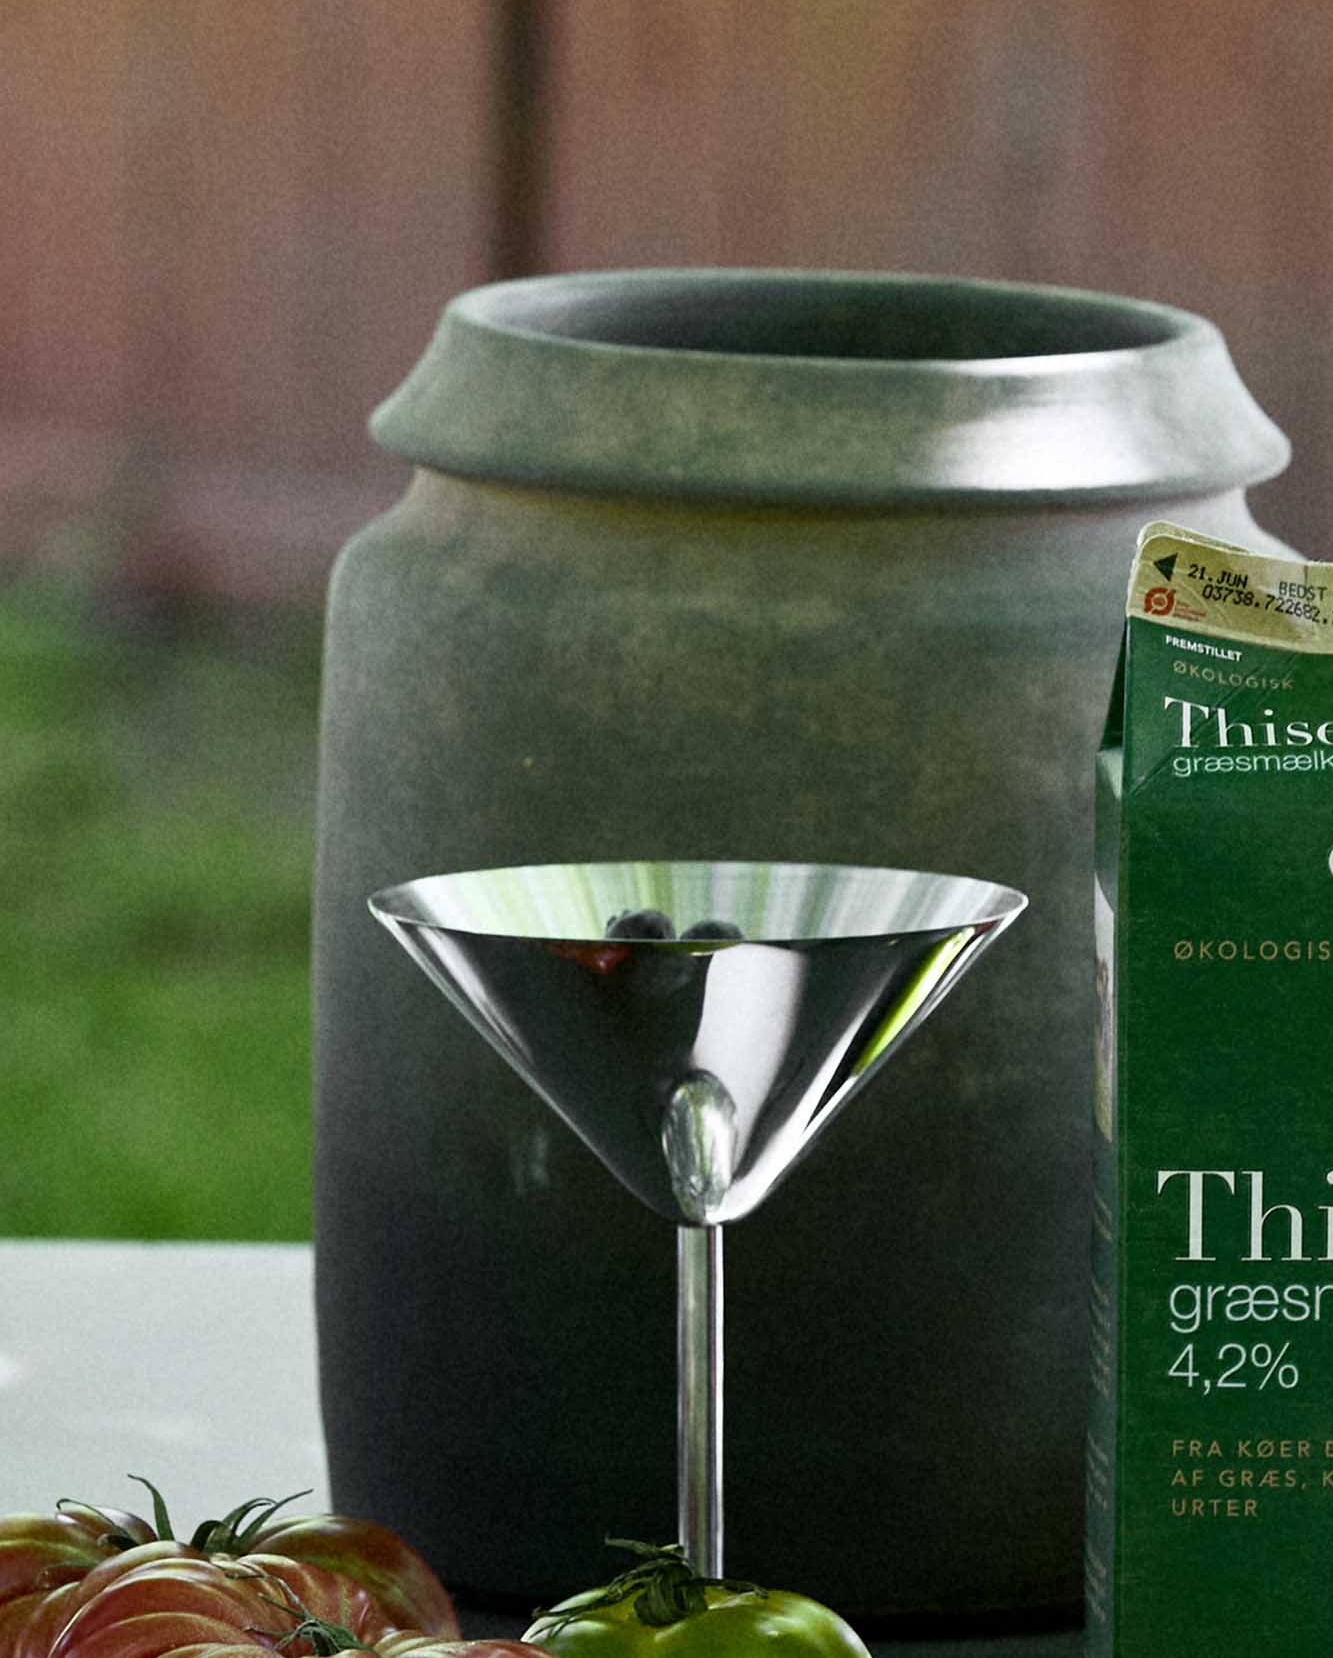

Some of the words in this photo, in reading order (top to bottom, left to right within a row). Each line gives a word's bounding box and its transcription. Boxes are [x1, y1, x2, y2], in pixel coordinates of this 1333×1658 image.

[1188, 564, 1248, 589] 21.JUN
[1278, 581, 1328, 601] BEDST
[1165, 634, 1243, 662] FREMSTILLET
[1172, 660, 1295, 690] ØKOLOGISK
[1168, 1341, 1300, 1396] 4,2%
[1170, 1439, 1224, 1458] FRA
[1236, 1439, 1312, 1459] KØER
[1170, 1469, 1210, 1487] AF
[1217, 1469, 1308, 1491] GRÆS,
[1170, 1497, 1259, 1517] URTER
